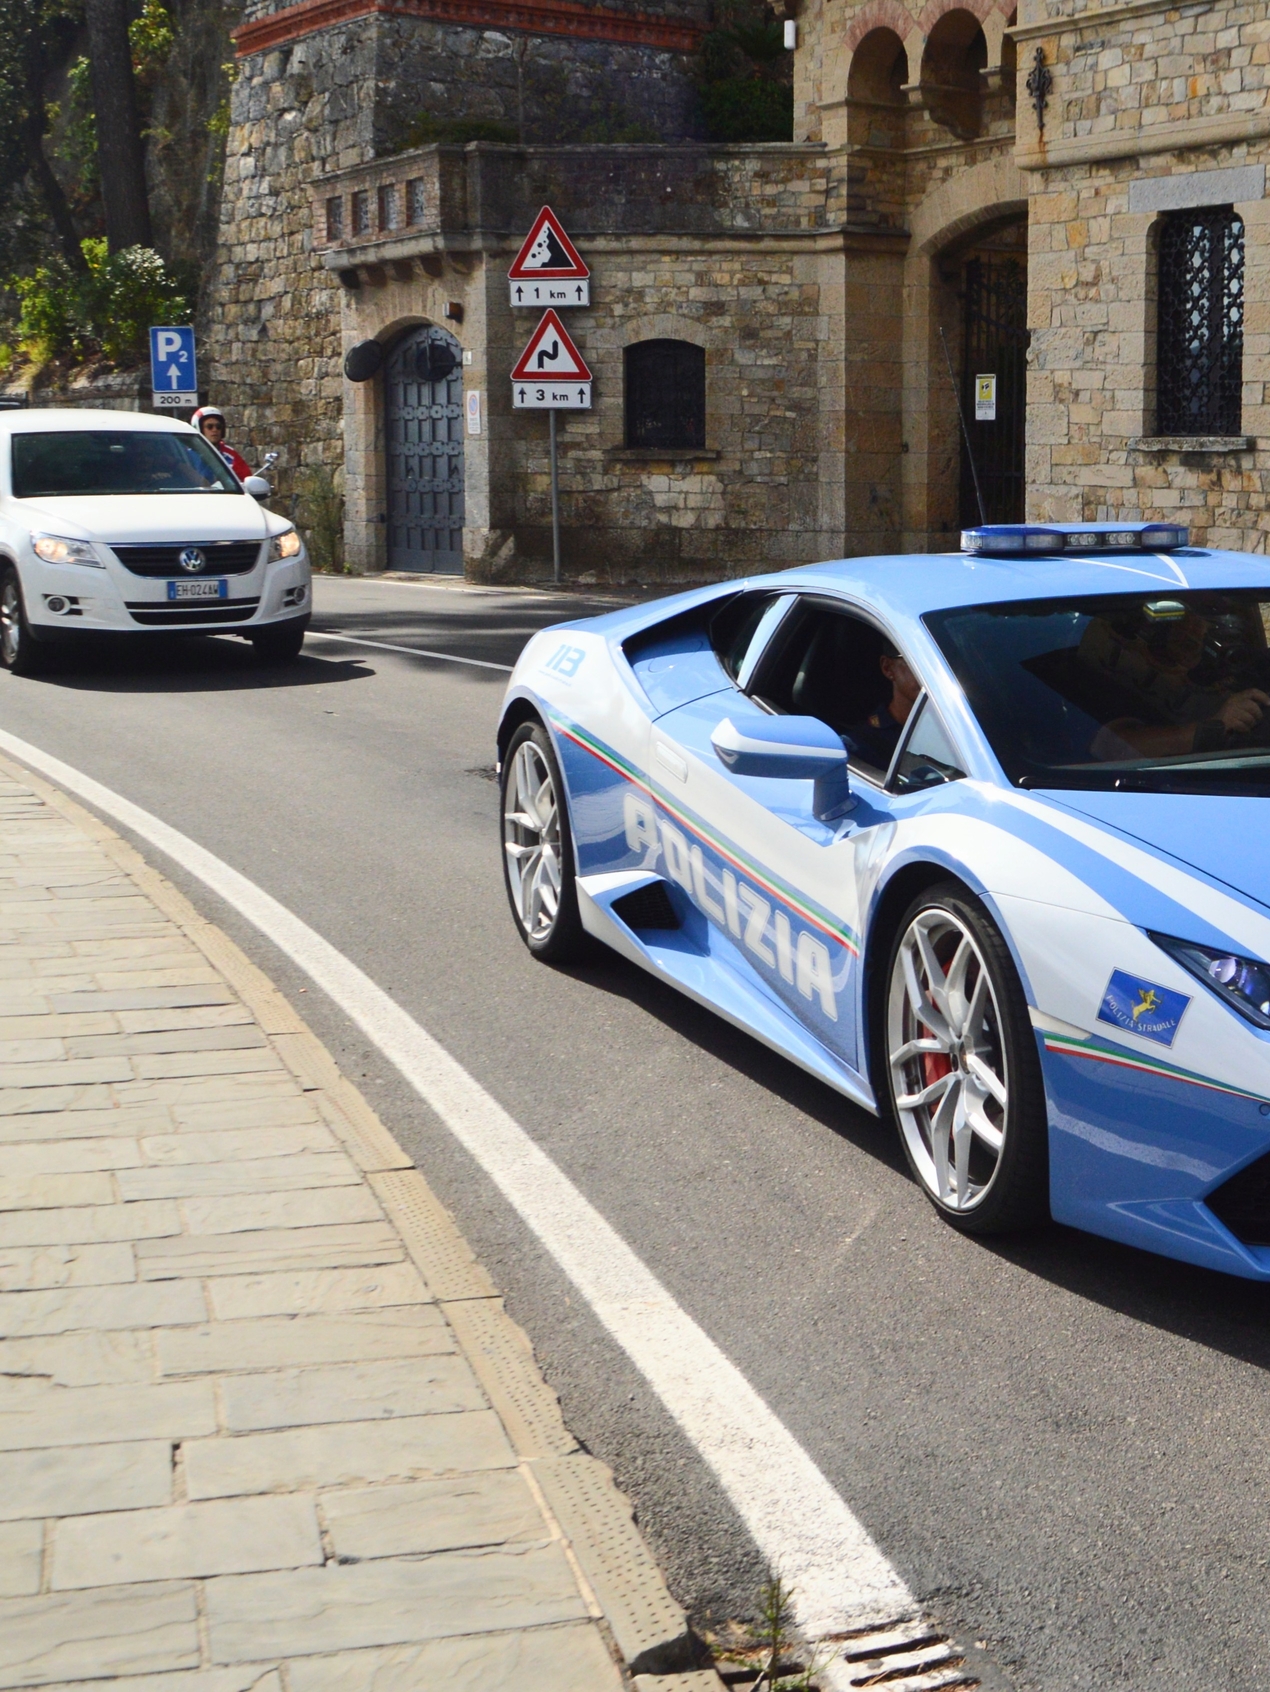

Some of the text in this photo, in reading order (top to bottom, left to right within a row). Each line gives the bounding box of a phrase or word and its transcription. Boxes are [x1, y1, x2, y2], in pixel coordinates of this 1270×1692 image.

[534, 287, 566, 299] 1 km
[160, 396, 181, 405] 200
[536, 389, 569, 401] 3 km
[545, 644, 586, 678] 113
[623, 793, 838, 1022] POLIZIA
[1106, 994, 1177, 1032] POLIZIA STRADALE
